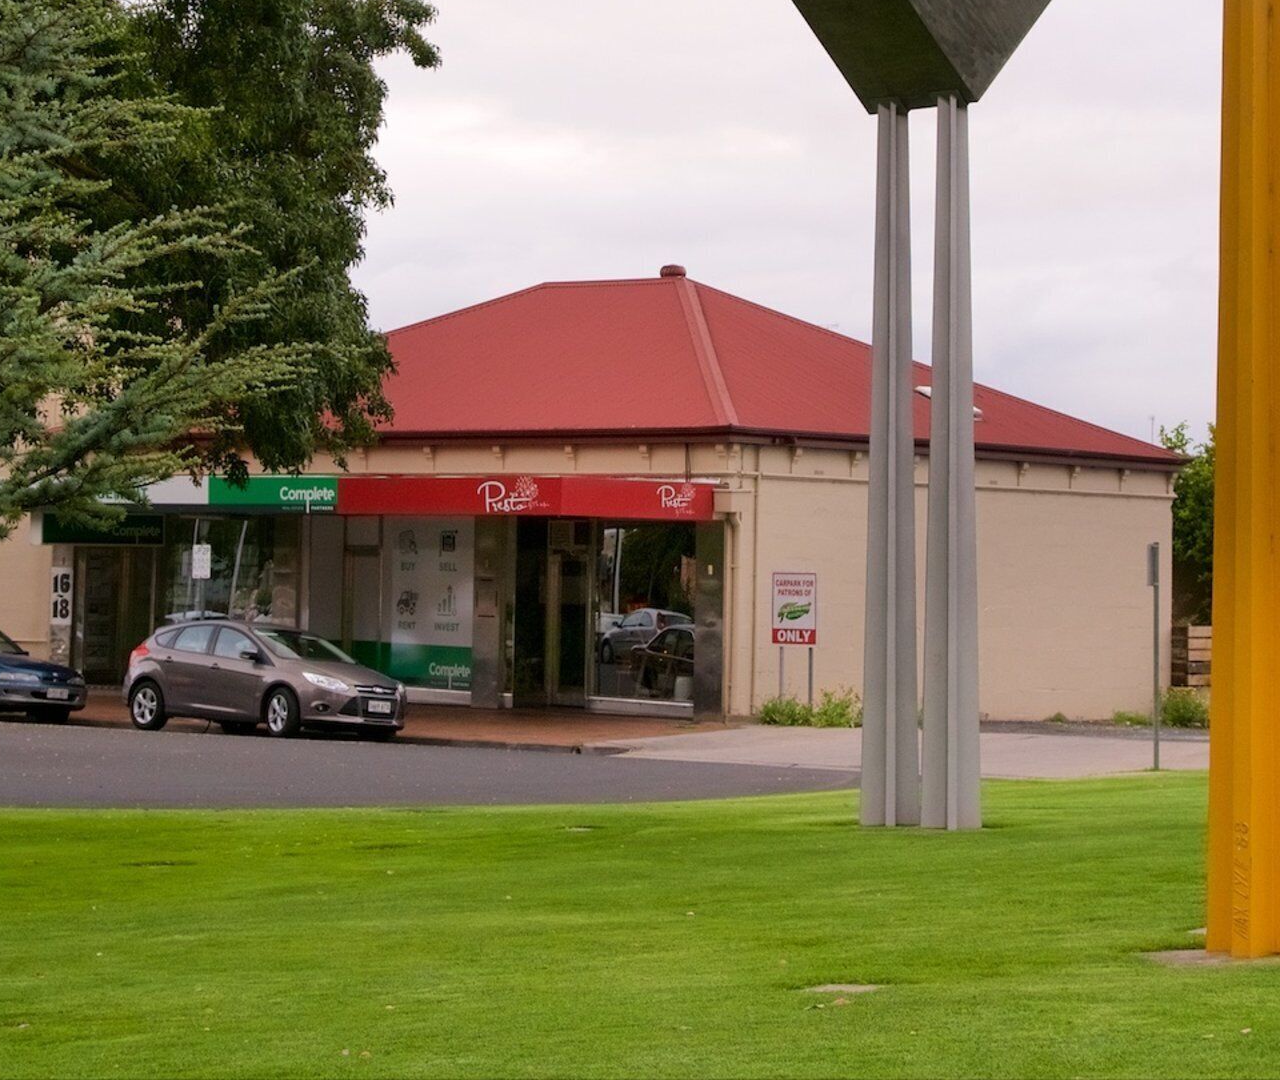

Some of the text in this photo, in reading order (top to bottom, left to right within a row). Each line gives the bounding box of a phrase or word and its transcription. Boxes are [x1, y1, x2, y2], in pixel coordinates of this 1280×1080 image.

[279, 486, 335, 514] Complete
[477, 481, 532, 513] Presto
[53, 574, 70, 594] 16
[52, 599, 69, 619] 18
[777, 629, 811, 643] ONLY
